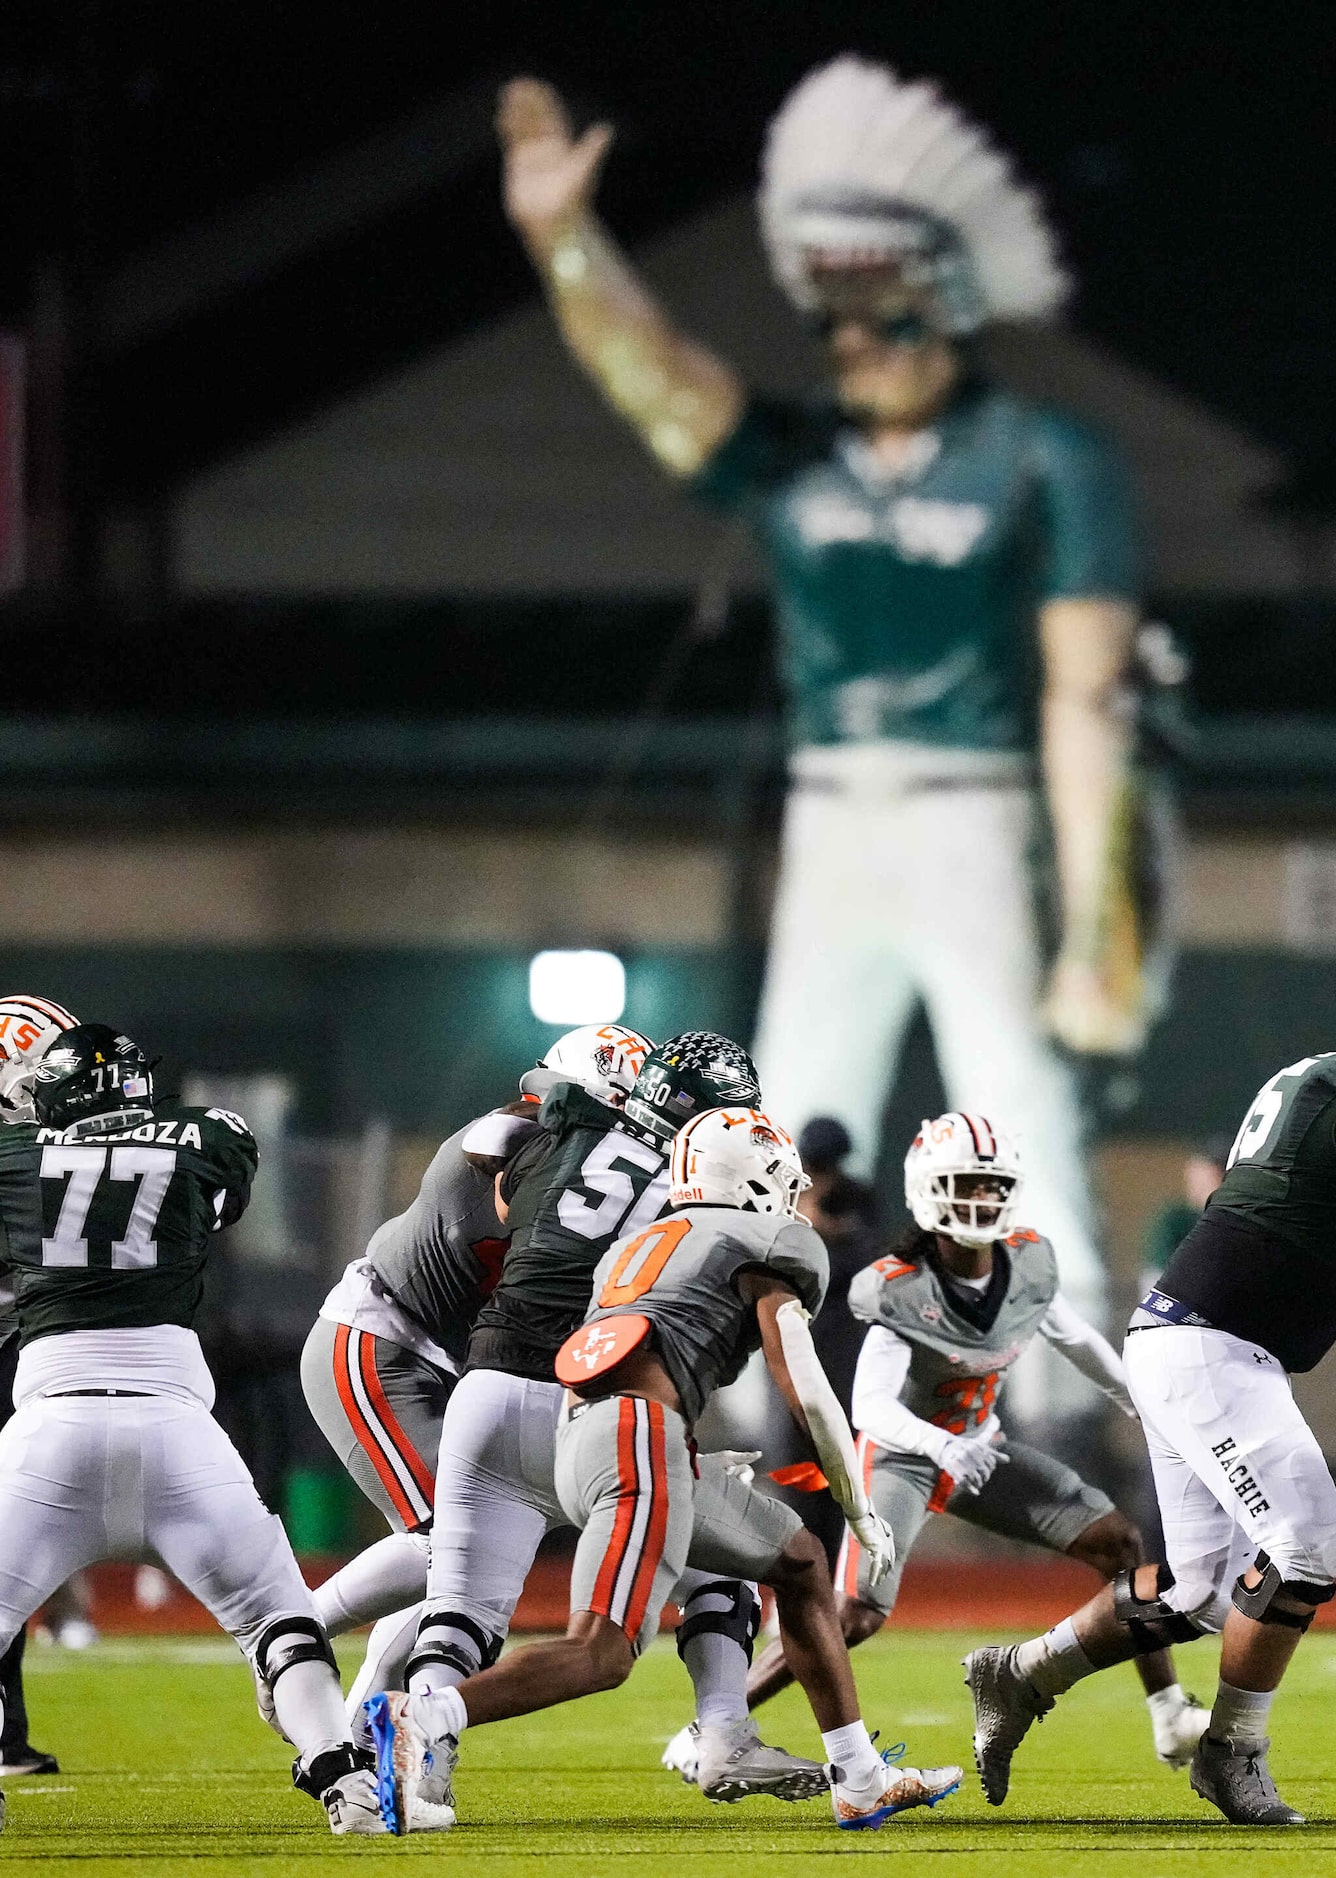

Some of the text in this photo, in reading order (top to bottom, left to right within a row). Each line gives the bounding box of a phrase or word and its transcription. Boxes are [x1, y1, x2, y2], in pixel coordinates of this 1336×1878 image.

[91, 1064, 120, 1092] 77
[39, 1145, 177, 1269] 77
[1211, 1437, 1271, 1518] HACHIE
